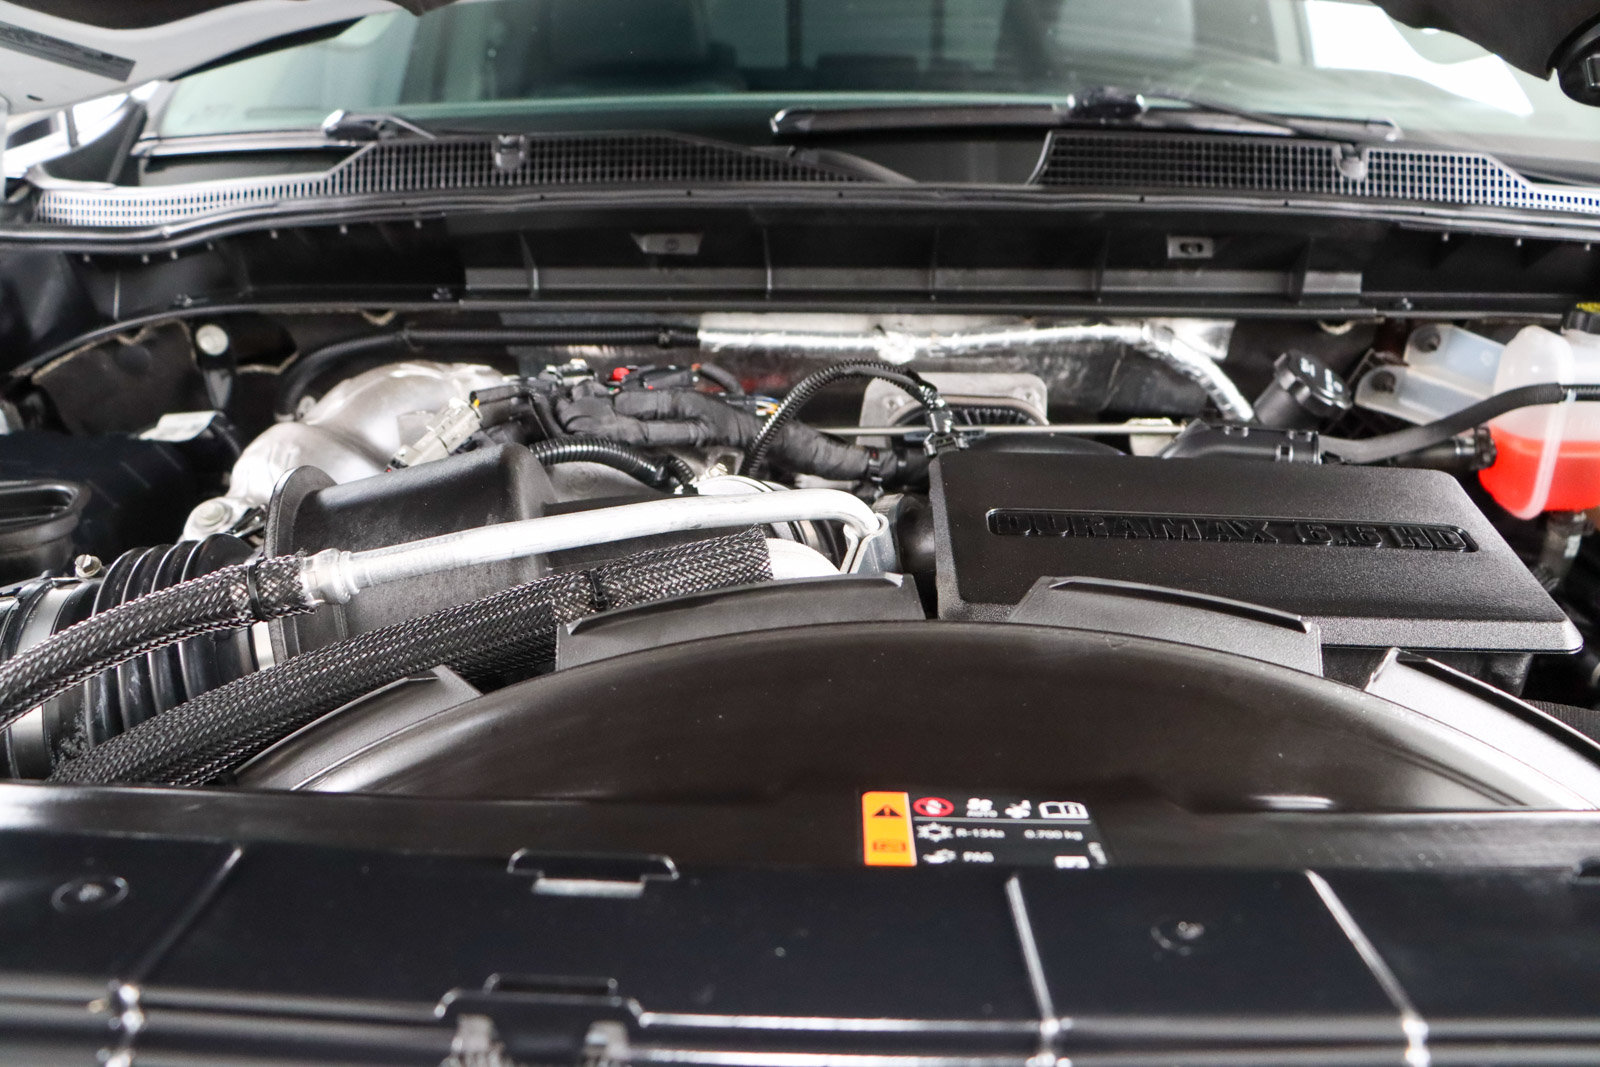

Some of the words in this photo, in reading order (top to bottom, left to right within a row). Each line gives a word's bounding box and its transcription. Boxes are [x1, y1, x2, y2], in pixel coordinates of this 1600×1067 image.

[996, 512, 1279, 543] DURAMAX
[1297, 521, 1383, 547] 6.6
[1391, 524, 1467, 551] HD
